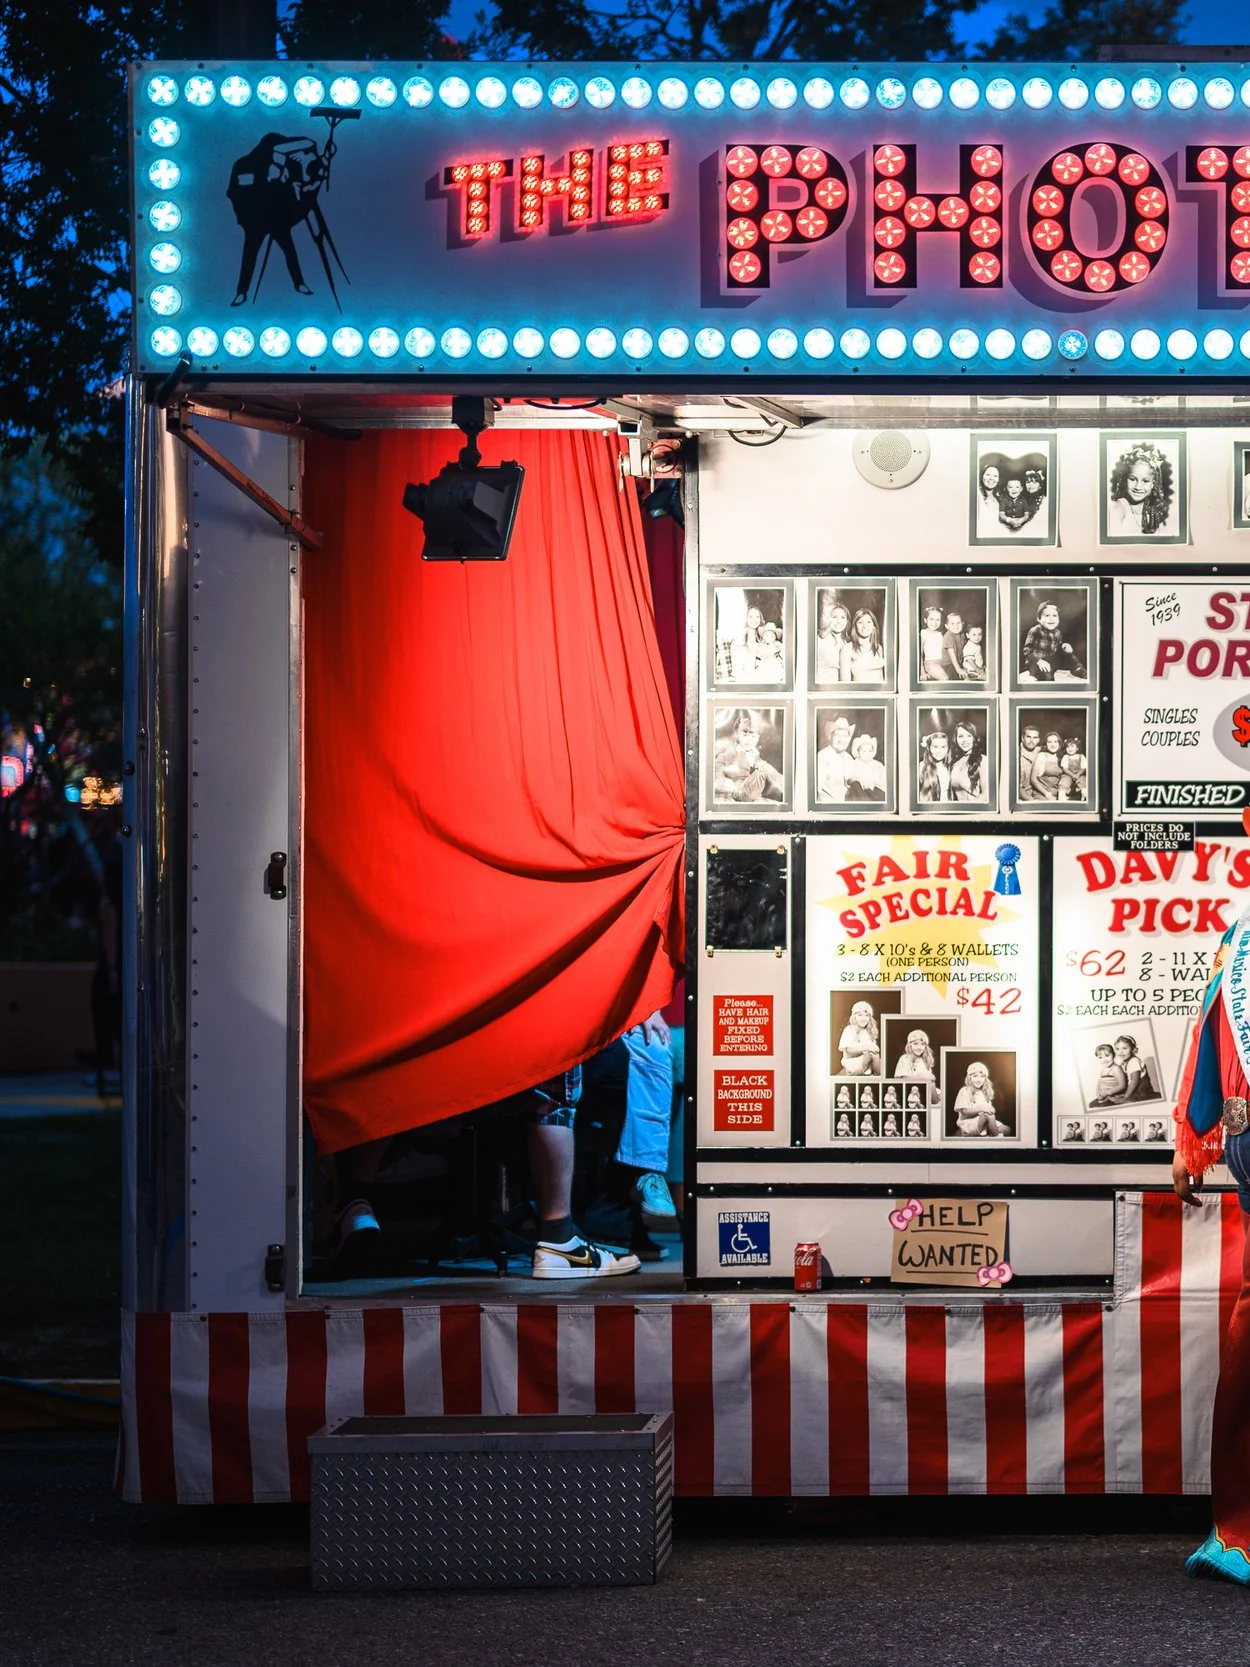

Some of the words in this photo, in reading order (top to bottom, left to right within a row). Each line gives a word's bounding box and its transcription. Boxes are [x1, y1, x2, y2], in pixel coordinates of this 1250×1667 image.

[445, 138, 670, 236] THE
[1145, 592, 1177, 612] Since
[1151, 604, 1181, 626] 1939
[1143, 708, 1198, 724] SINGLES
[1141, 730, 1200, 747] COUPLES
[1135, 784, 1245, 805] FINISHED
[1126, 824, 1164, 832] PRICES
[1169, 824, 1183, 832] DO
[1118, 832, 1138, 841] NOT
[1144, 832, 1191, 841] INCLUDE
[1130, 841, 1179, 849] FOLDERS
[836, 850, 970, 897] FAIR
[839, 887, 998, 938] SPECIAL
[1108, 898, 1230, 933] PICK
[836, 943, 846, 956] 3
[859, 943, 868, 956] 8
[874, 943, 885, 956] X
[889, 943, 916, 956] 10's
[919, 943, 933, 956] &
[936, 943, 946, 956] 8
[951, 943, 1019, 956] WALLETS
[886, 957, 914, 967] (ONE
[918, 957, 969, 967] PERSON)
[1066, 950, 1126, 976] $62
[1141, 951, 1153, 965] 2
[1172, 951, 1186, 965] 11
[1193, 951, 1207, 965] X
[840, 972, 855, 982] $2
[858, 972, 890, 982] EACH
[894, 972, 966, 982] ADDITIONAL
[970, 972, 1017, 982] PERSON
[1139, 967, 1153, 982] 8
[957, 987, 1021, 1015] $42
[1090, 988, 1116, 1002] UP
[1122, 988, 1146, 1002] TO
[1153, 988, 1164, 1002] 5
[719, 1008, 743, 1016] HAVE
[746, 1008, 768, 1016] HAIR
[1057, 1004, 1073, 1016] $2
[1076, 1005, 1108, 1016] EACH
[1112, 1005, 1145, 1016] EACH
[1148, 1005, 1201, 1016] ADDITIO
[719, 1017, 734, 1025] AND
[737, 1017, 768, 1025] MAKEUP
[728, 1026, 760, 1034] FIXED
[724, 1035, 764, 1043] BEFORE
[720, 1044, 768, 1052] ENTERING
[722, 1076, 768, 1086] BLACK
[718, 1089, 772, 1099] BACKGROUND
[727, 1103, 762, 1112] THIS
[727, 1115, 762, 1124] SIDE
[719, 1211, 769, 1223] ASSISTANCE
[919, 1202, 994, 1227] HELP
[721, 1253, 768, 1265] AVAILABLE
[898, 1240, 998, 1268] WANTED
